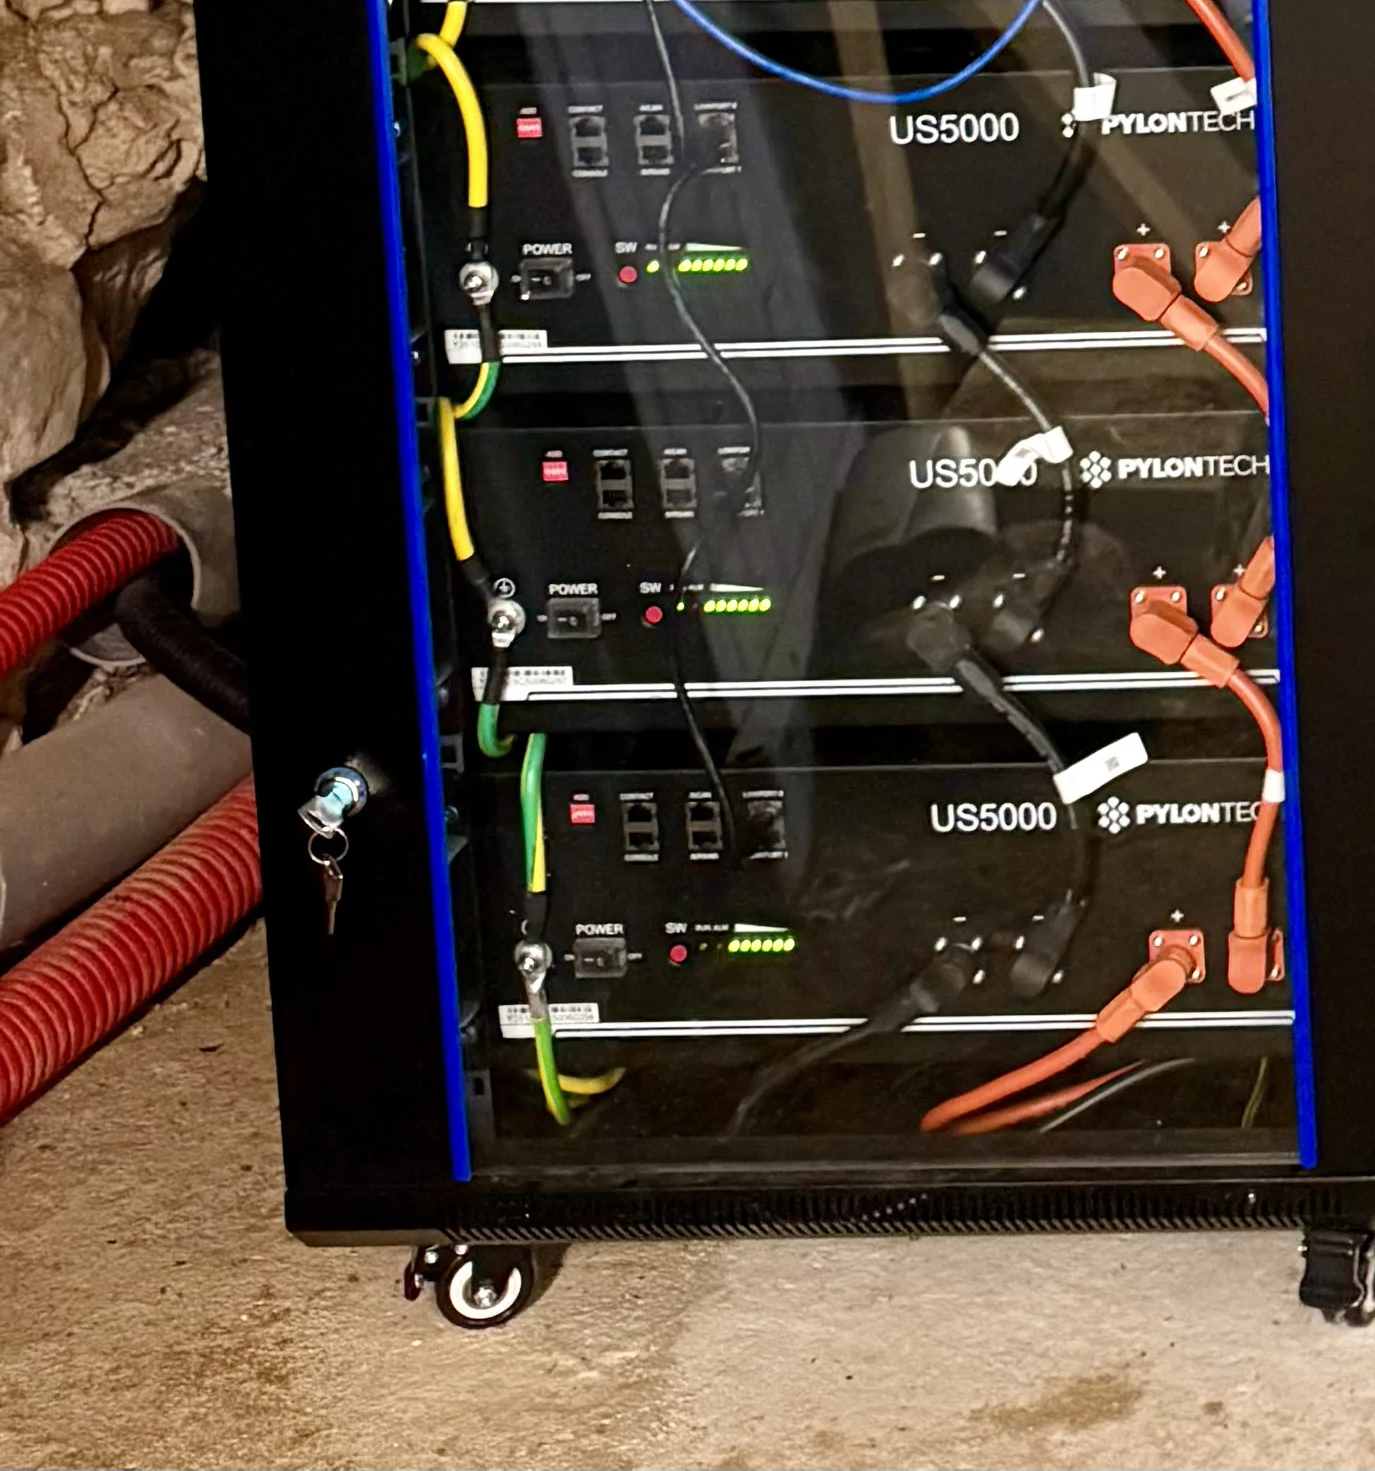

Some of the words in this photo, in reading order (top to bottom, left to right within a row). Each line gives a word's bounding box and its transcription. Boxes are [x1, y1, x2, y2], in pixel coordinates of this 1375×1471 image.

[889, 111, 1020, 145] US5000
[1101, 110, 1256, 136] PYLONTECH
[521, 243, 573, 256] POWER
[614, 242, 638, 254] SW
[908, 458, 1038, 489] US500
[1117, 454, 1271, 479] PYLONTECH
[548, 583, 599, 596] POWER
[639, 582, 662, 594] SW
[930, 801, 1057, 834] US5000
[1136, 801, 1263, 825] PYLONTEC
[575, 924, 625, 936] POWER
[664, 922, 688, 934] SW
